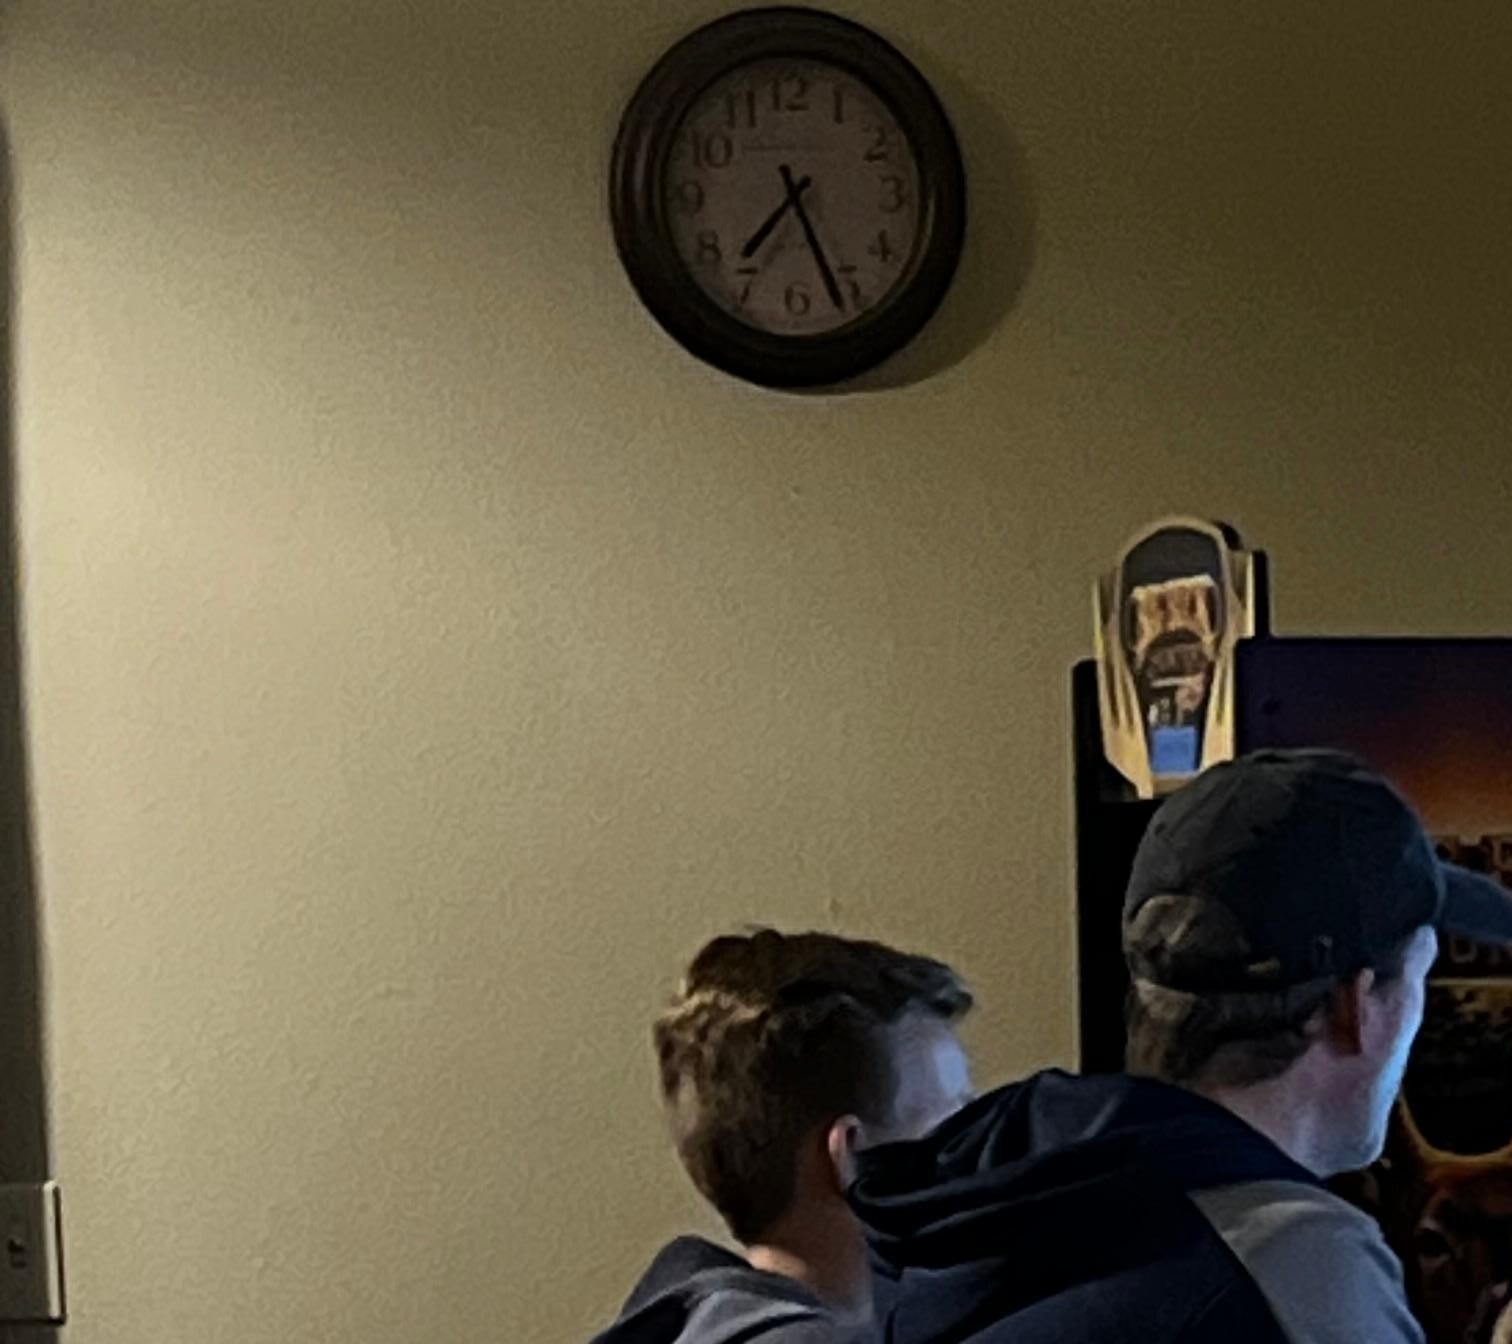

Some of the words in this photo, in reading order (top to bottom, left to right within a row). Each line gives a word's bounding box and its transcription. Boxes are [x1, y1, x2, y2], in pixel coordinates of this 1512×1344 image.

[726, 90, 757, 128] 11
[770, 77, 809, 112] 12
[690, 128, 734, 168] 10
[863, 125, 888, 163] 2
[880, 176, 905, 213] 3
[697, 229, 723, 264] 8
[867, 229, 891, 264] 4
[735, 266, 760, 305] 7
[783, 282, 811, 317] 6
